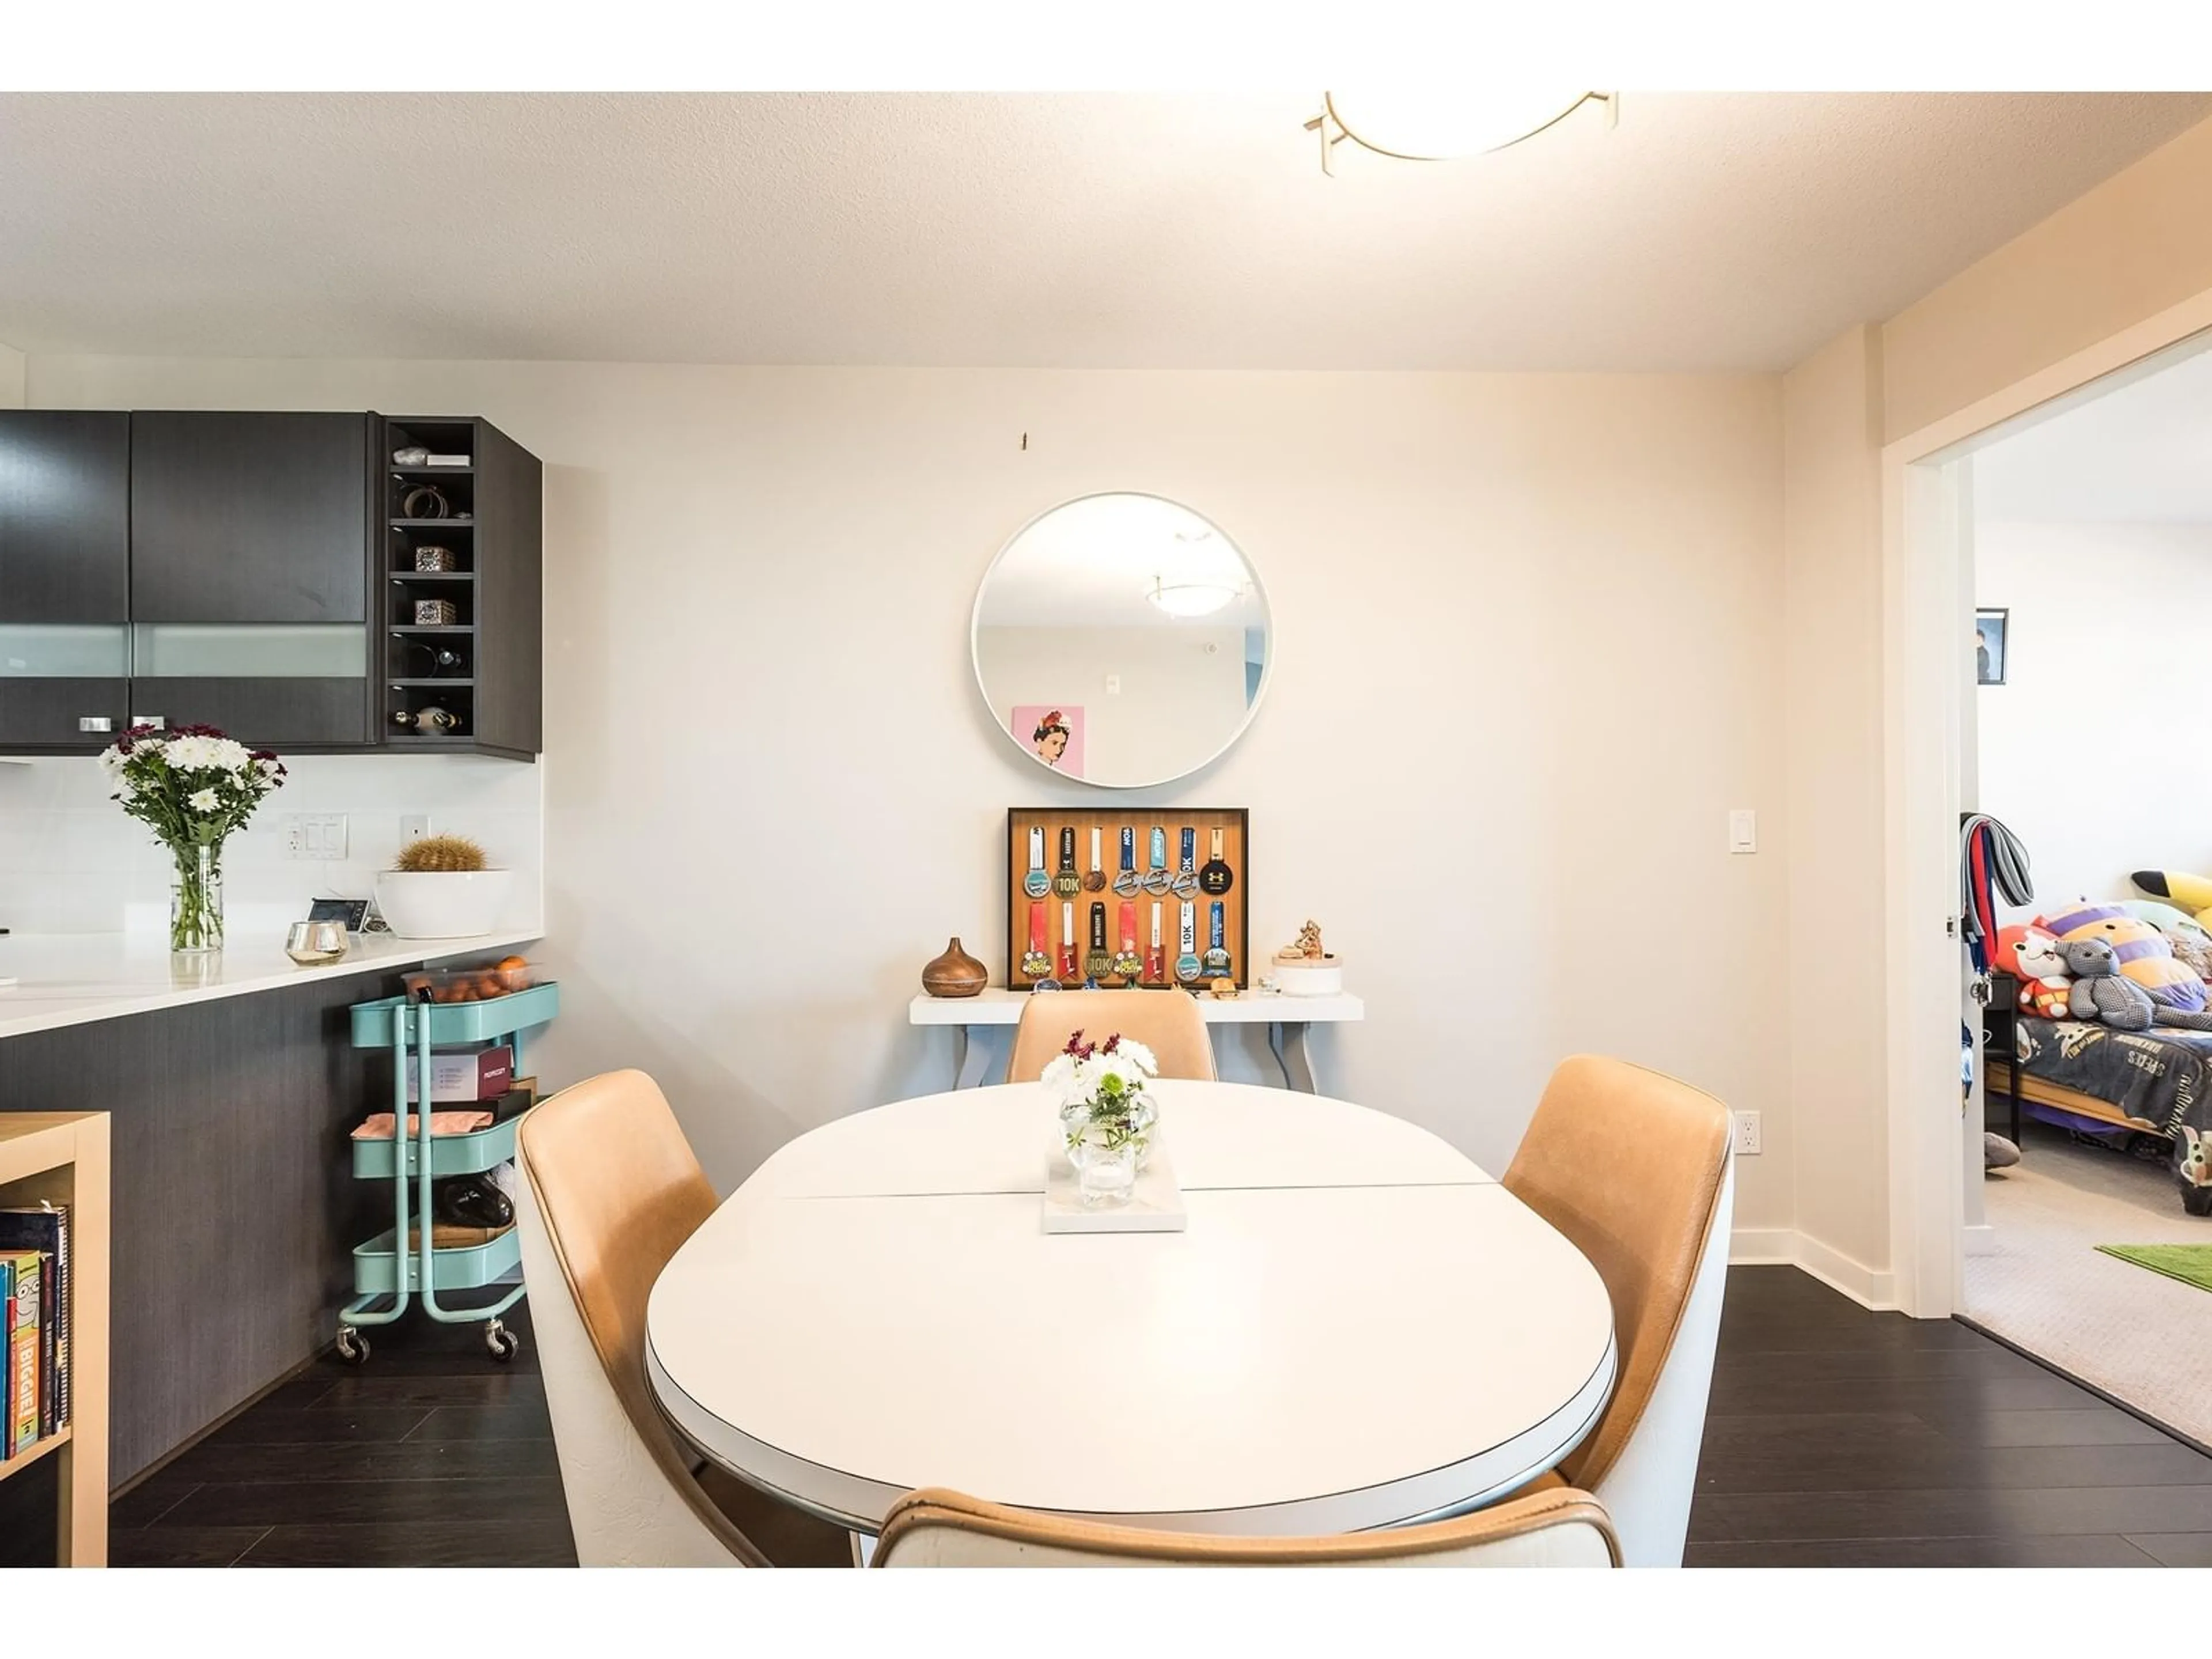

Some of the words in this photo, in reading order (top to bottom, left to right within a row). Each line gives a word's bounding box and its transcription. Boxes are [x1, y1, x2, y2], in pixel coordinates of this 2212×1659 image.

[1059, 877, 1080, 892] 10K
[1183, 925, 1192, 945] 10K
[1090, 958, 1111, 971] 10K
